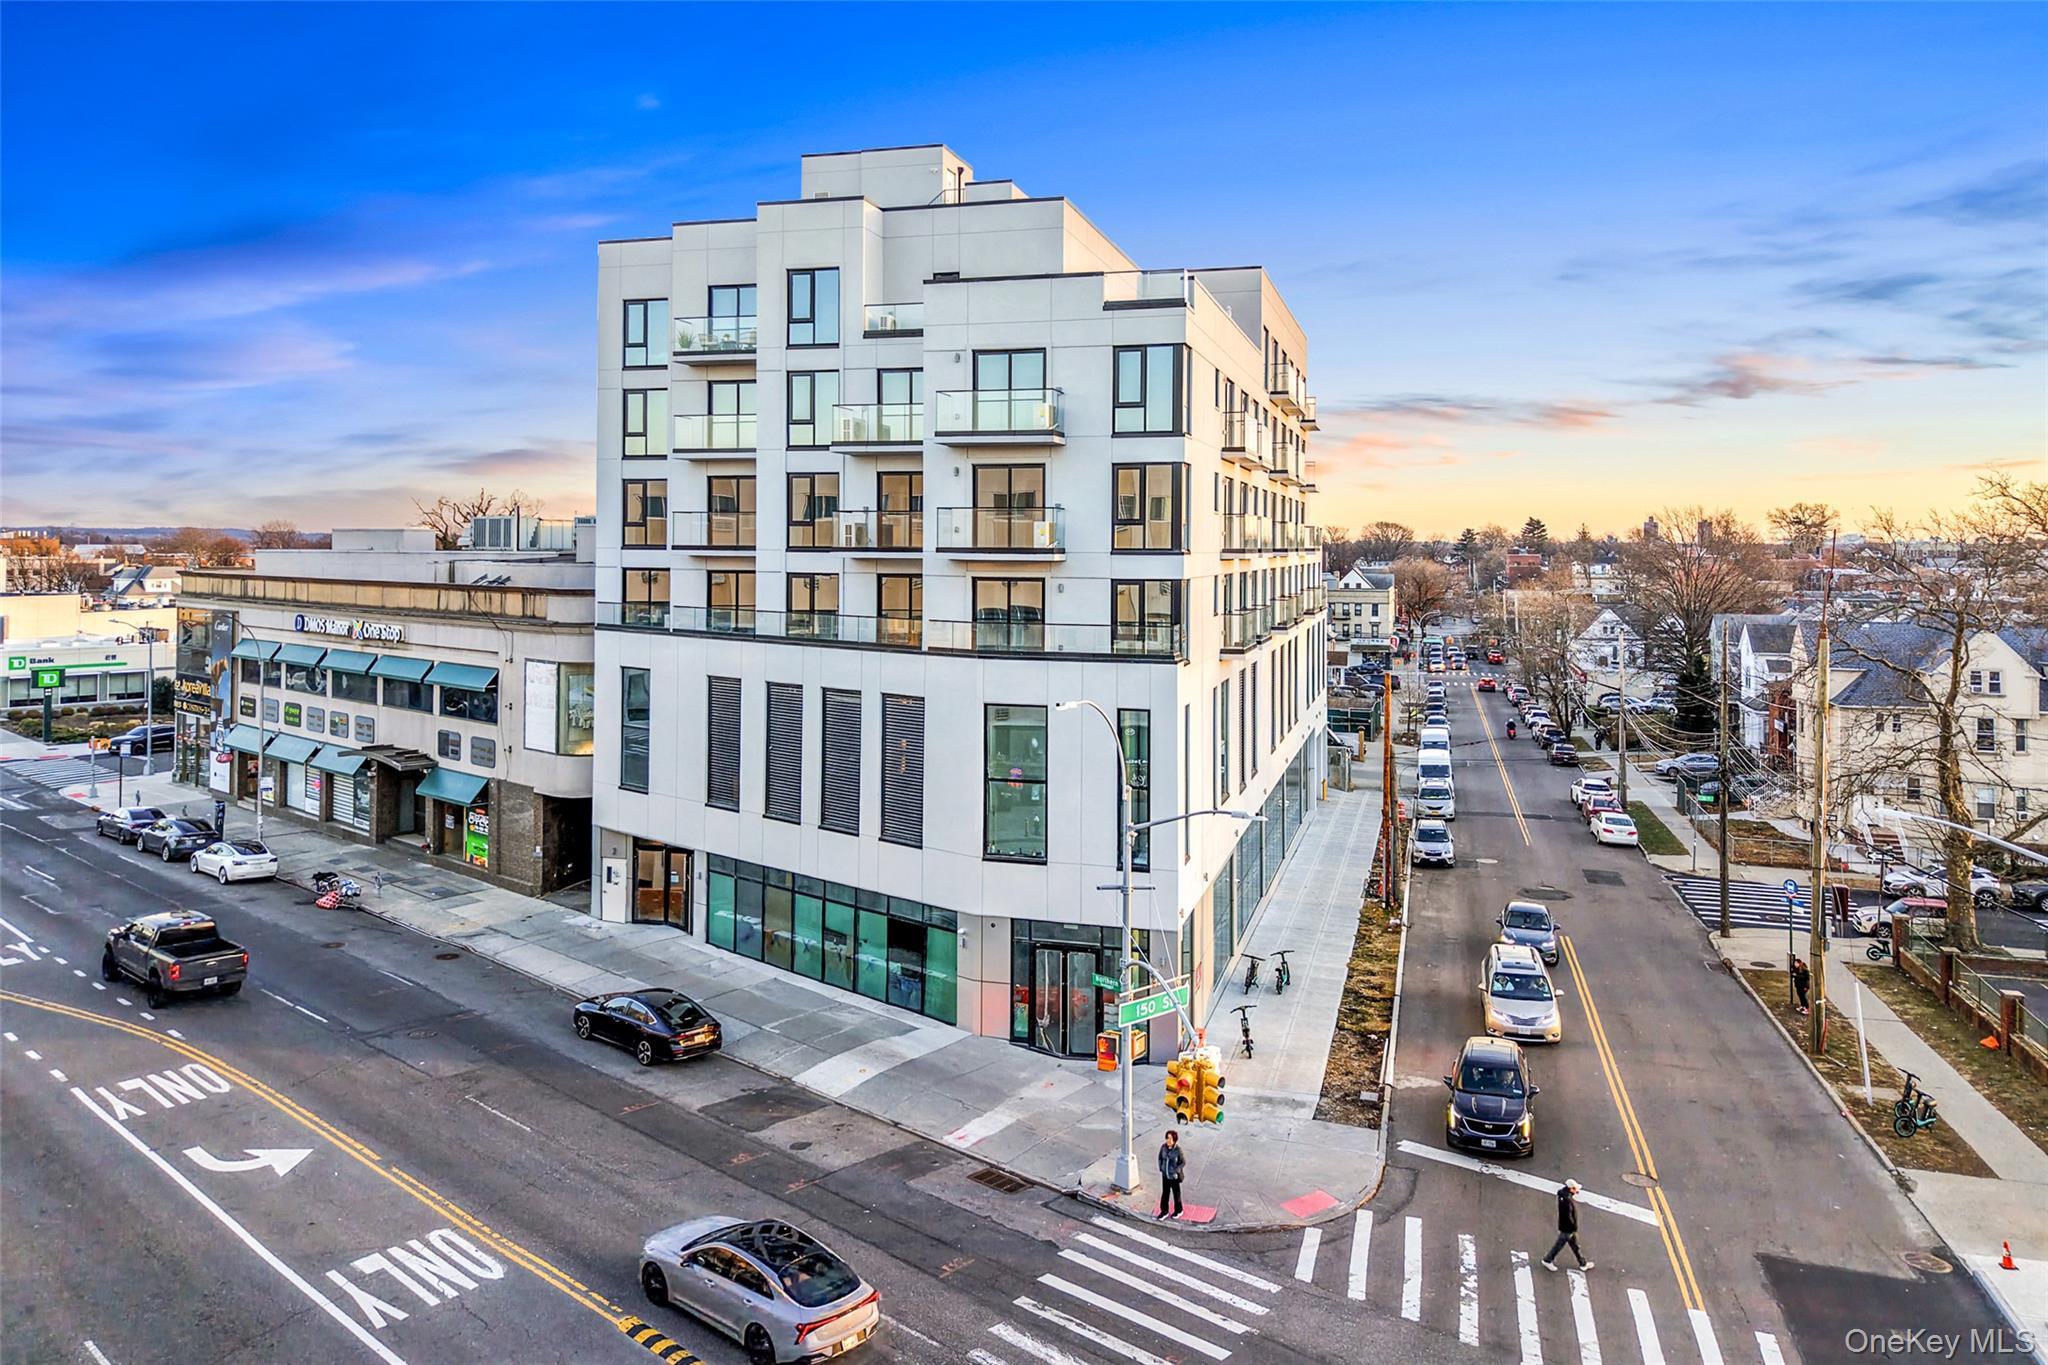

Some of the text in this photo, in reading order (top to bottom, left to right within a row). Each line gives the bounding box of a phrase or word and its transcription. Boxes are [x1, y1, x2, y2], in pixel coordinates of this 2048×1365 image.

[304, 617, 326, 634] DMOS
[10, 658, 25, 668] TD
[41, 674, 57, 684] TD
[1135, 1000, 1156, 1018] 150
[96, 1062, 233, 1120] ONLY
[325, 1228, 505, 1329] ONLY
